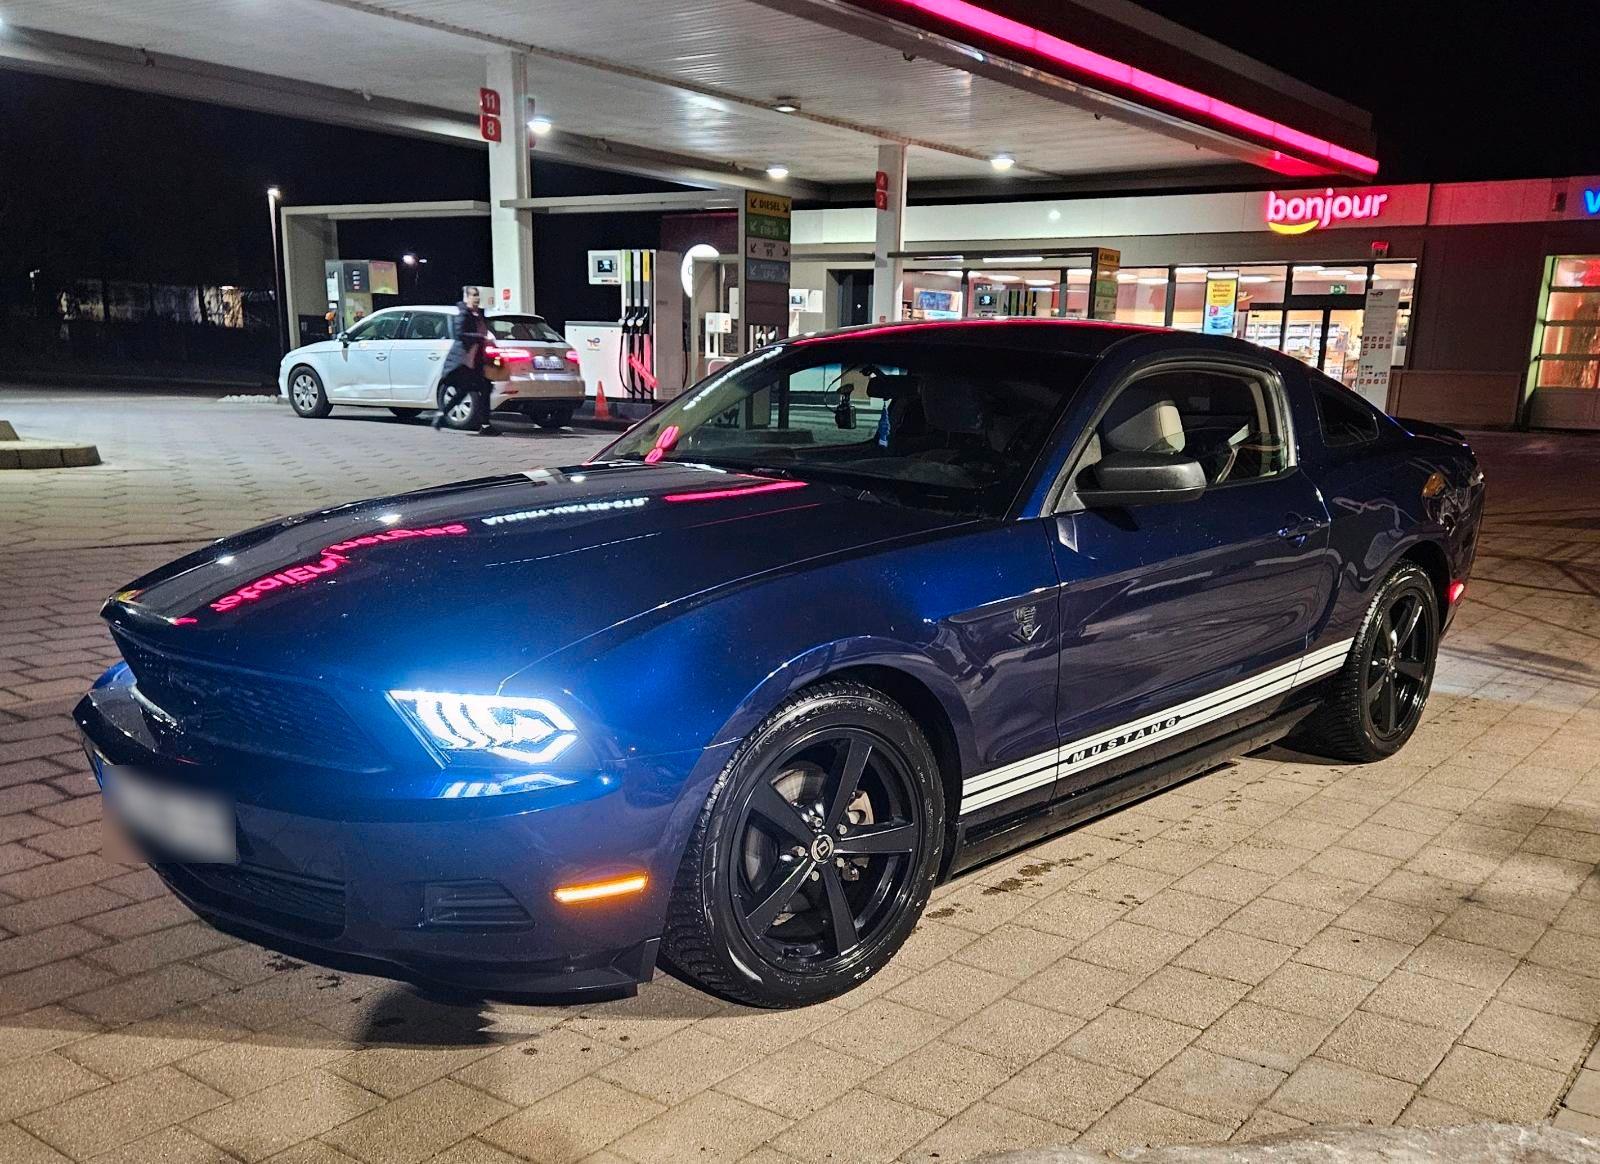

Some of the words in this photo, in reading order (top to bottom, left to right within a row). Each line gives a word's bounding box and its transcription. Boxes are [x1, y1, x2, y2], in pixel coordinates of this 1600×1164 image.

[485, 93, 495, 109] 11
[487, 120, 496, 136] 8
[759, 199, 781, 211] DIESEL
[1266, 188, 1388, 228] bonjour
[1072, 717, 1177, 763] MUSTANG
